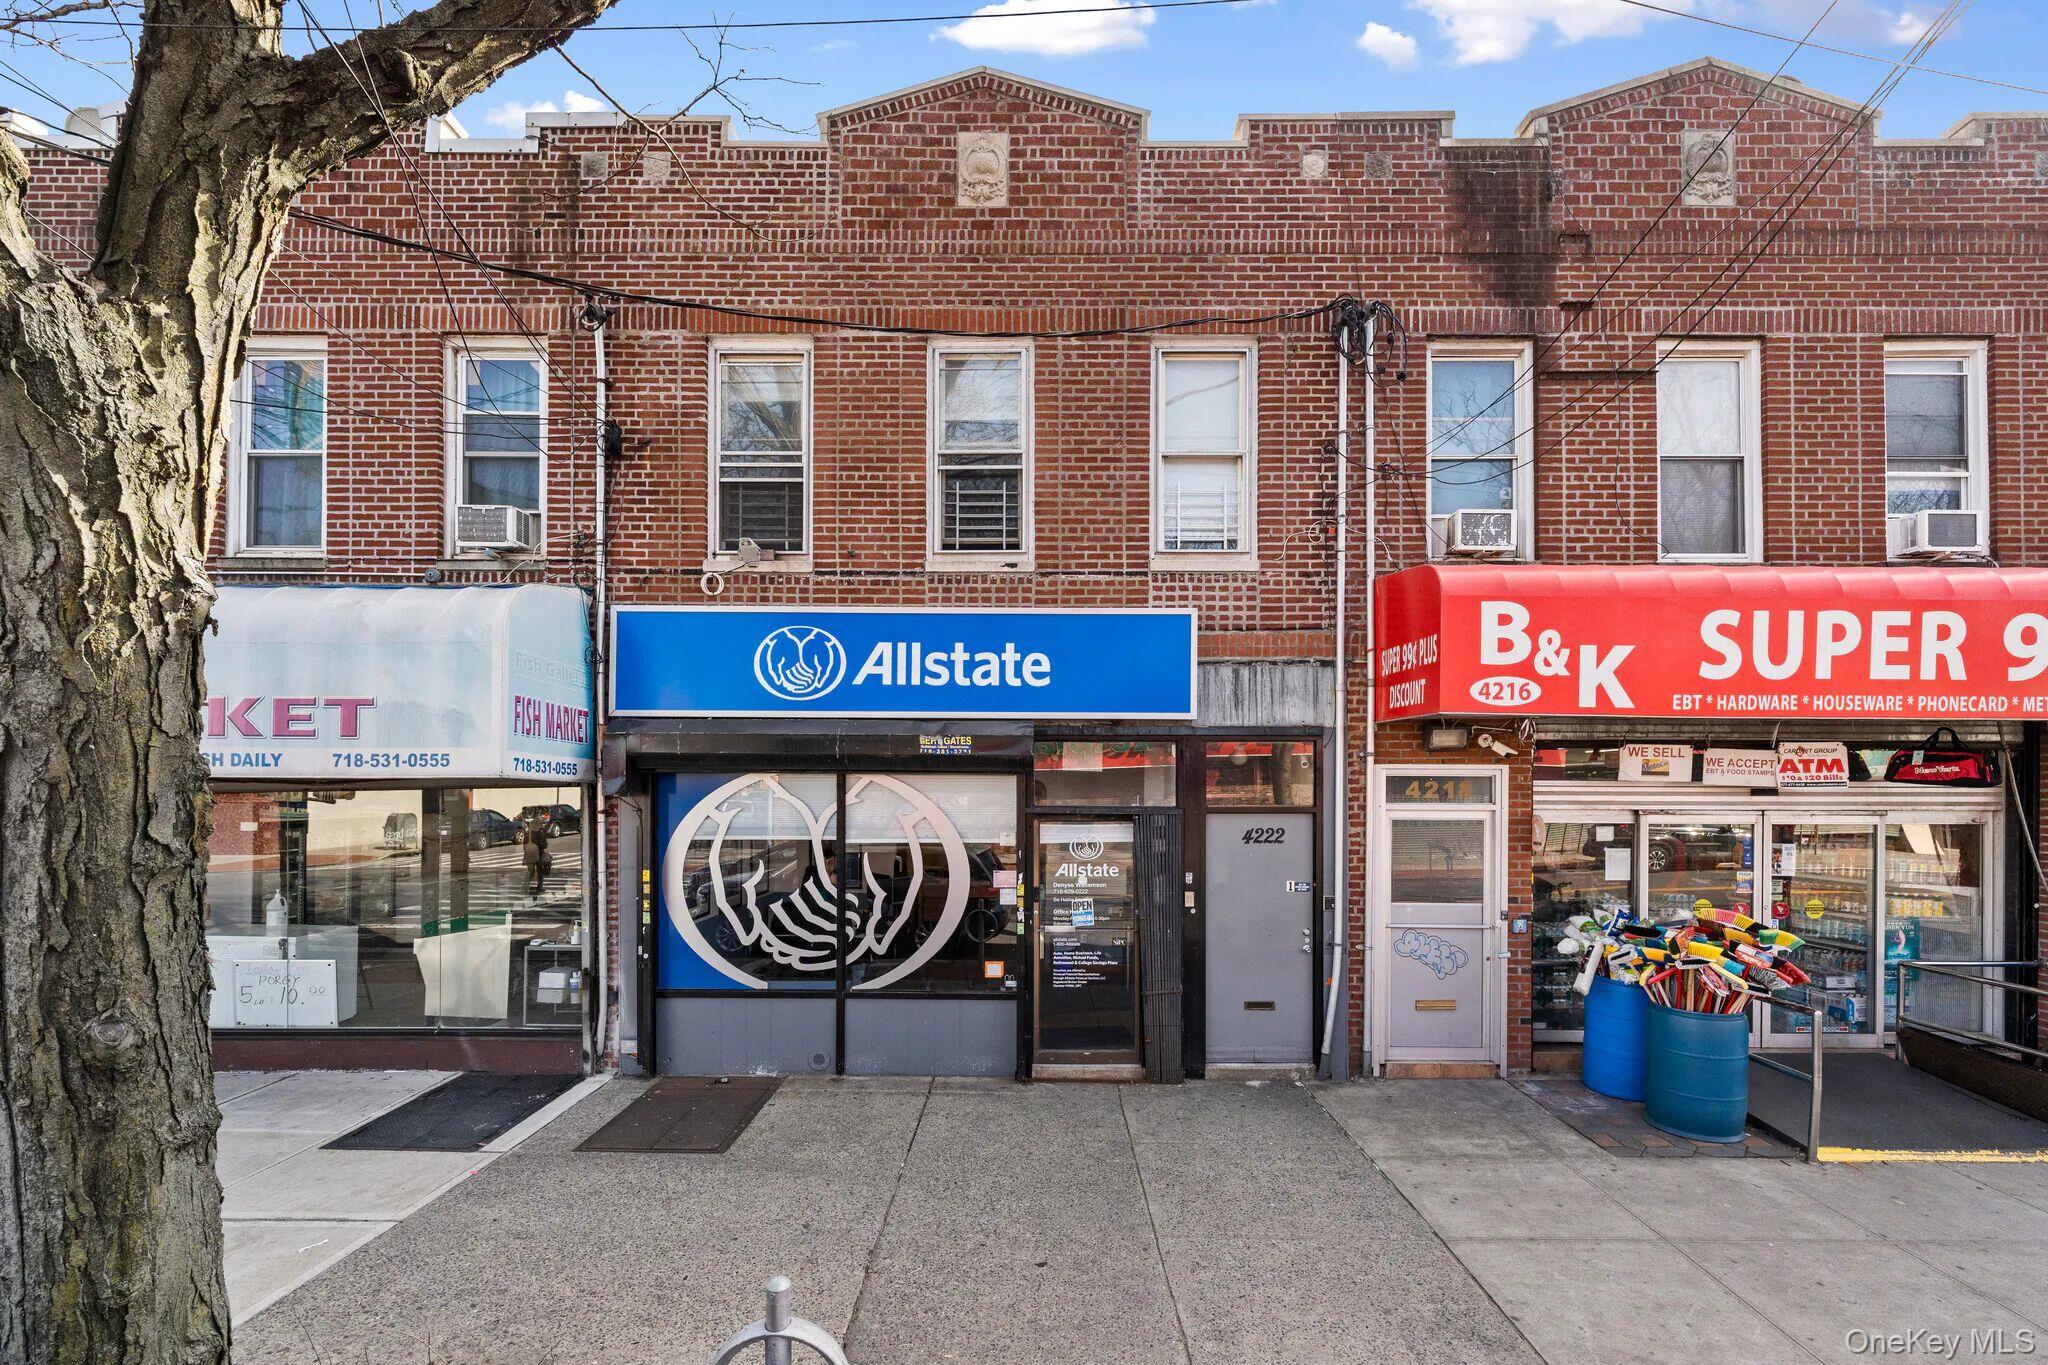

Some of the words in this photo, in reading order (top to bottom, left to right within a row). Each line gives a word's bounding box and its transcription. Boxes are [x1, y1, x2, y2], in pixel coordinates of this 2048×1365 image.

[1698, 609, 1968, 681] SUPER
[1381, 645, 1401, 677] SUPER
[1419, 633, 1438, 667] PLUS
[1480, 600, 1636, 709] B&K
[852, 642, 1051, 686] Allstate
[1389, 678, 1426, 709] DISCOUNT
[1478, 682, 1532, 701] 4216
[1672, 694, 1703, 711] EBT
[1717, 694, 1798, 711] HARDWARE
[1813, 695, 1903, 712] HOUSEWARE
[1917, 696, 2008, 712] PHONECARD
[207, 696, 377, 739] KET
[513, 694, 541, 738] FISH
[545, 702, 589, 744] MARKET
[944, 736, 972, 745] GATES
[230, 752, 284, 768] DAILY
[332, 752, 450, 768] 718-531-0555
[1627, 746, 1649, 757] WE
[1652, 747, 1686, 758] SELL
[513, 757, 578, 776] 718-531-0555
[1705, 757, 1724, 767] WE
[1726, 758, 1776, 769] ACCEPT
[1779, 758, 1845, 773] ATM
[1747, 769, 1776, 777] STAMPS
[1241, 827, 1286, 845] 4222
[1055, 863, 1119, 877] Allstate
[1073, 901, 1093, 911] OPEN
[259, 974, 301, 985] PORGY
